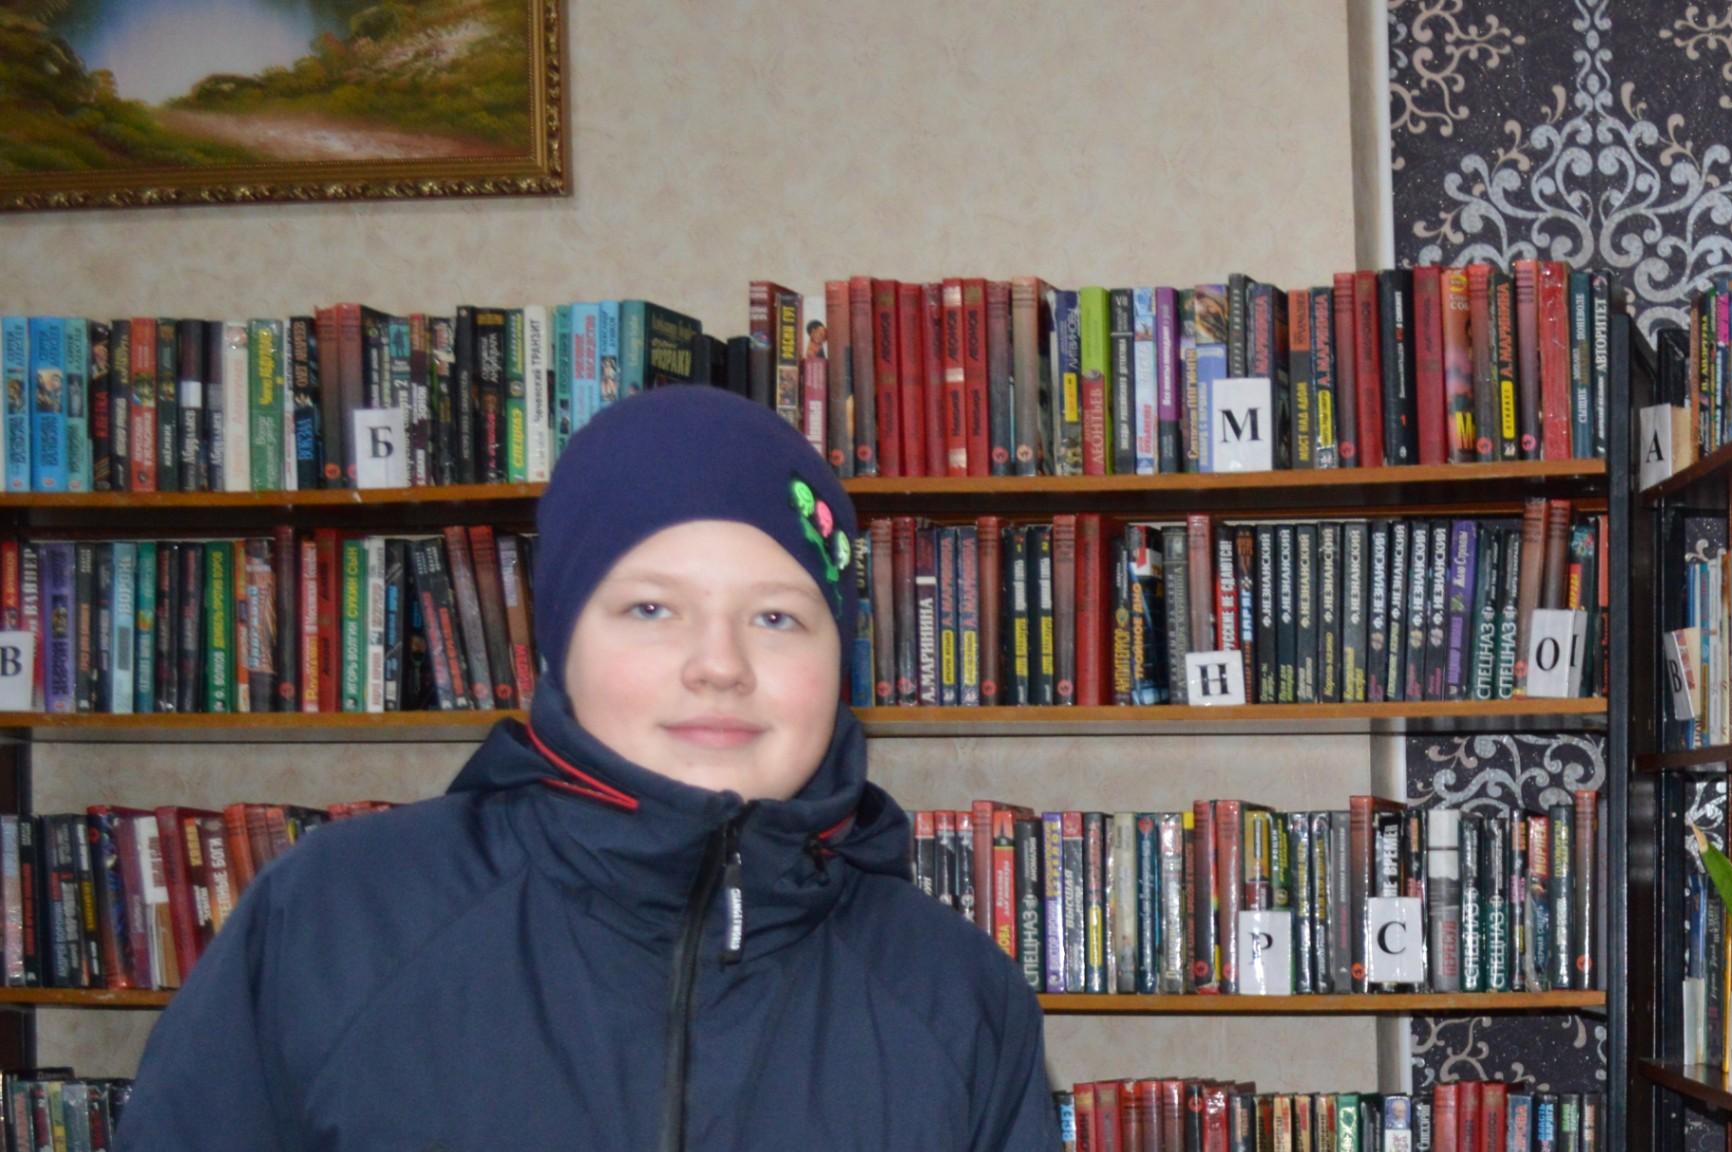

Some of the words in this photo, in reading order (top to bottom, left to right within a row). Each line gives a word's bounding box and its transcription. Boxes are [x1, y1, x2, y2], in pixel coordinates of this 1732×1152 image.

[1497, 283, 1511, 362] МАРИНИНА
[1595, 296, 1608, 372] АВТОРИТЕТ
[368, 426, 394, 458] Б
[1217, 407, 1263, 443] М
[1645, 429, 1665, 464] А
[1373, 532, 1386, 614] НЕЗНАНСКИЙ
[1412, 529, 1427, 611] НЕЗНАНСКИЙ
[1433, 527, 1447, 610] НЕЗНАНСКИЙ
[0, 645, 22, 678] В
[1199, 663, 1230, 697] Н
[1476, 623, 1495, 700] СПЕЦНАЗ
[1498, 622, 1516, 700] СПЕЦНАЗ
[1535, 637, 1560, 672] О
[1023, 910, 1041, 985] СПЕЦНАЗ
[1377, 920, 1407, 955] С
